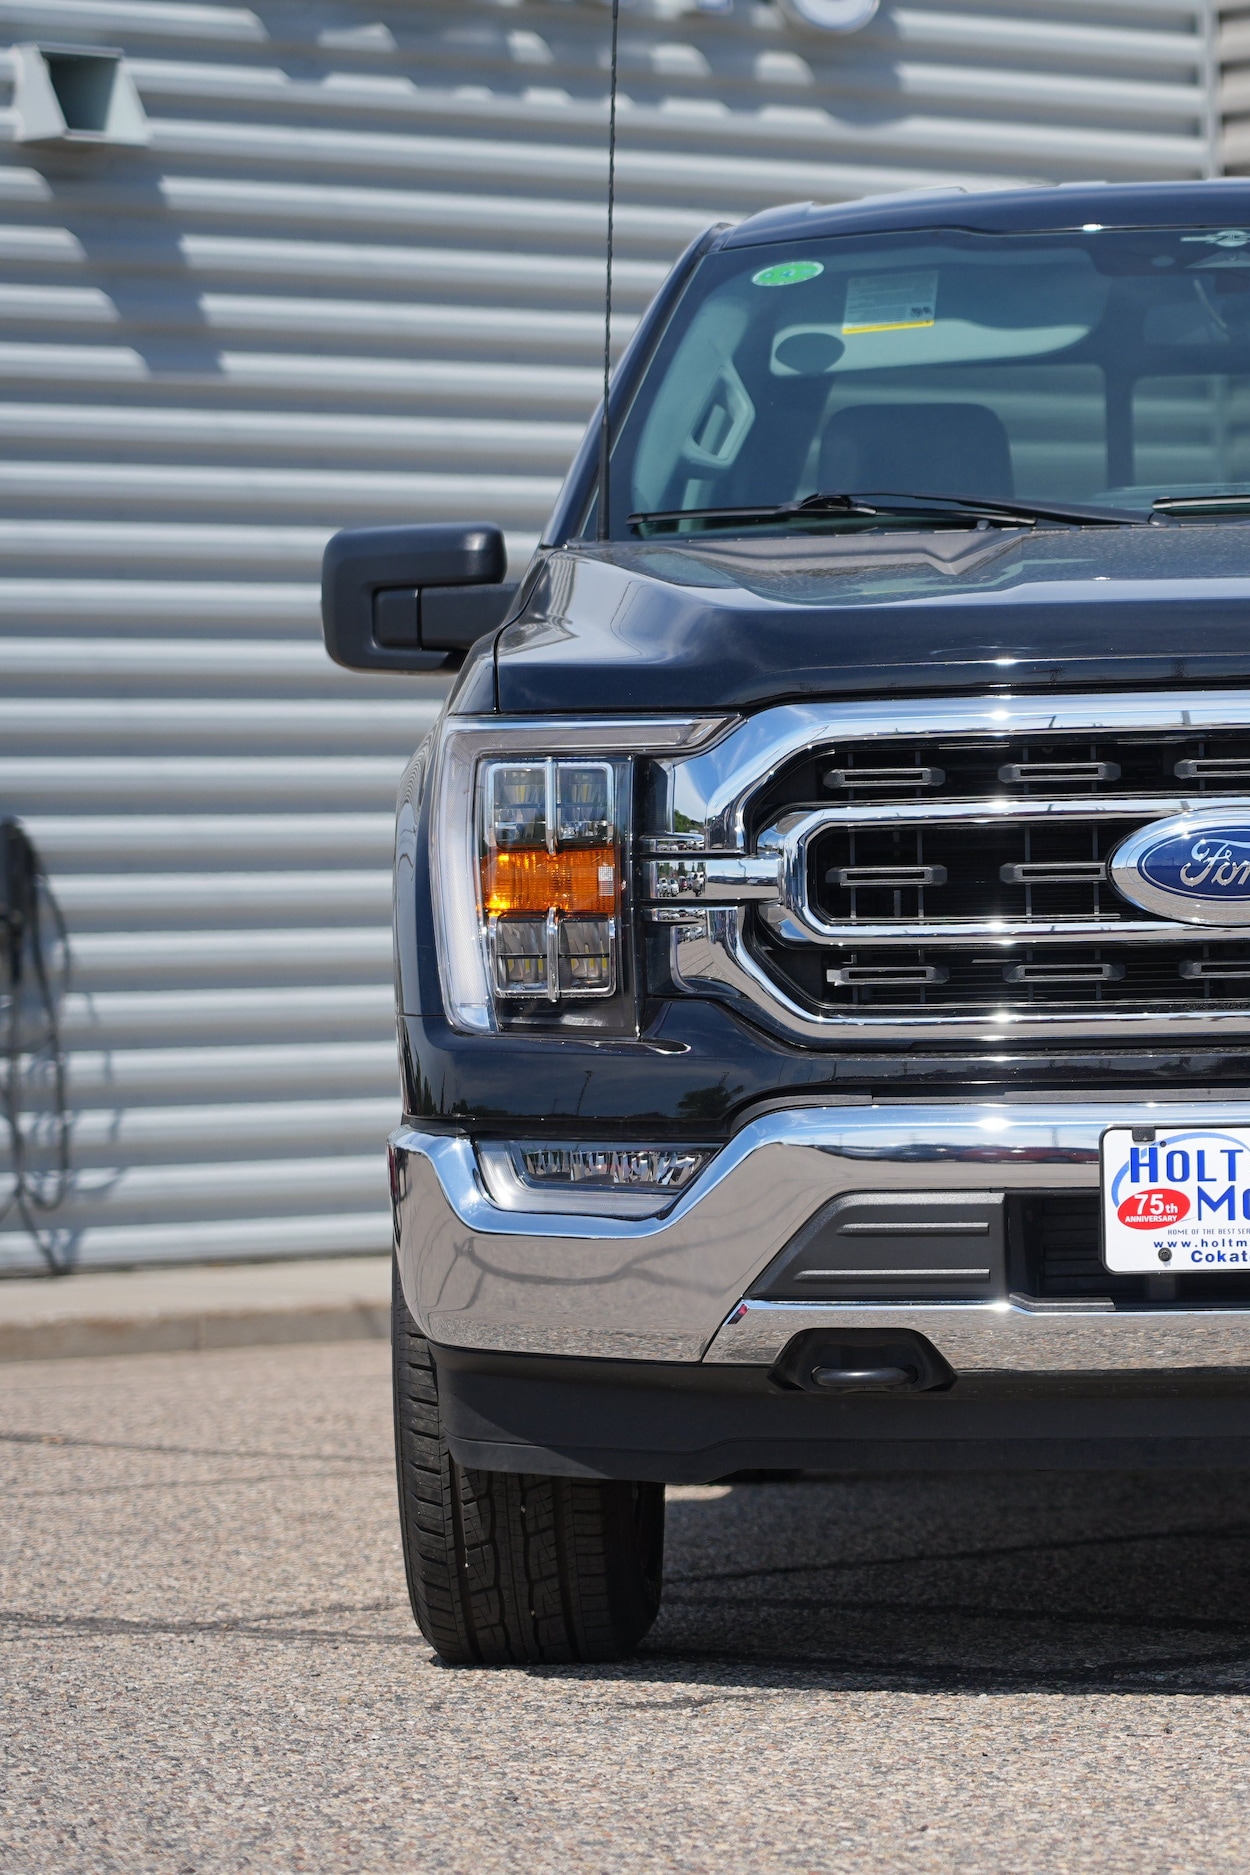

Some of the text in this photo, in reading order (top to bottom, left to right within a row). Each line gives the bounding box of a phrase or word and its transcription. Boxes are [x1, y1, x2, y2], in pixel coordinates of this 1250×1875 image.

[1130, 1147, 1244, 1183] HOLT
[1134, 1193, 1178, 1215] 75th
[1125, 1214, 1178, 1223] ANNIVERSARY
